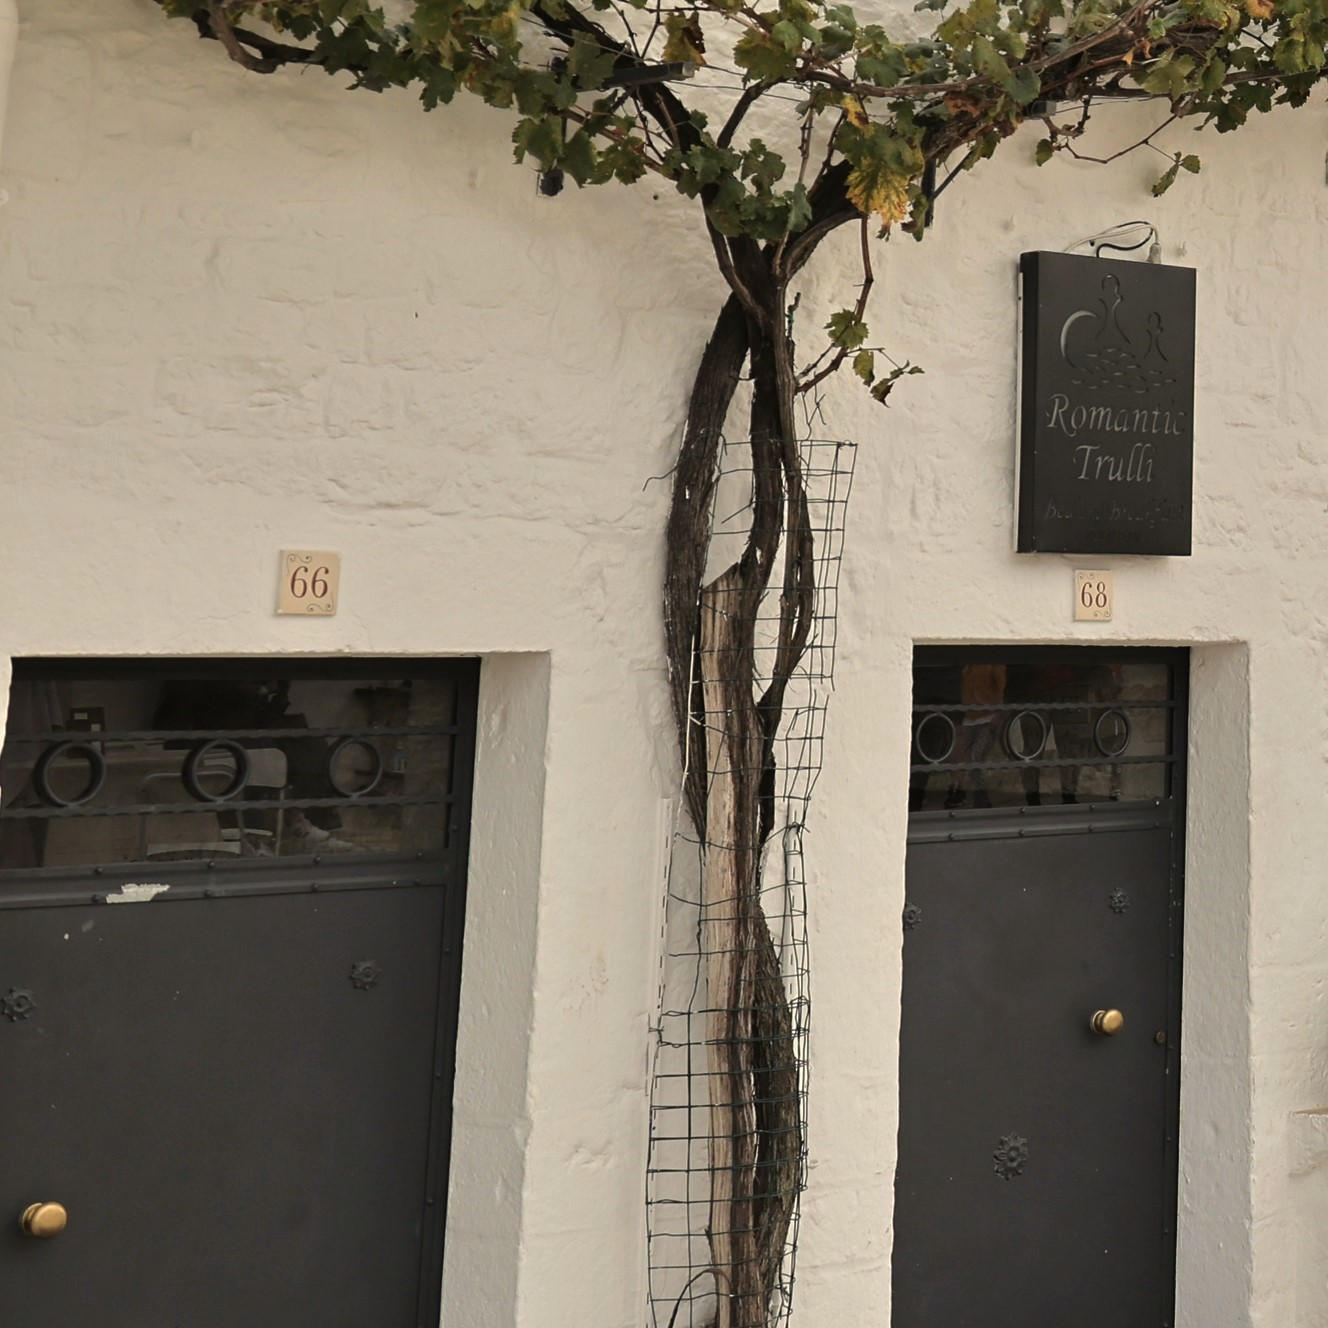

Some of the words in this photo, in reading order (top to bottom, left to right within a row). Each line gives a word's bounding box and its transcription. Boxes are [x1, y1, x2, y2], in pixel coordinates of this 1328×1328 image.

[1047, 393, 1185, 438] Romantic
[1075, 442, 1154, 482] Trulli
[290, 565, 330, 599] 66
[1081, 581, 1107, 608] 68
